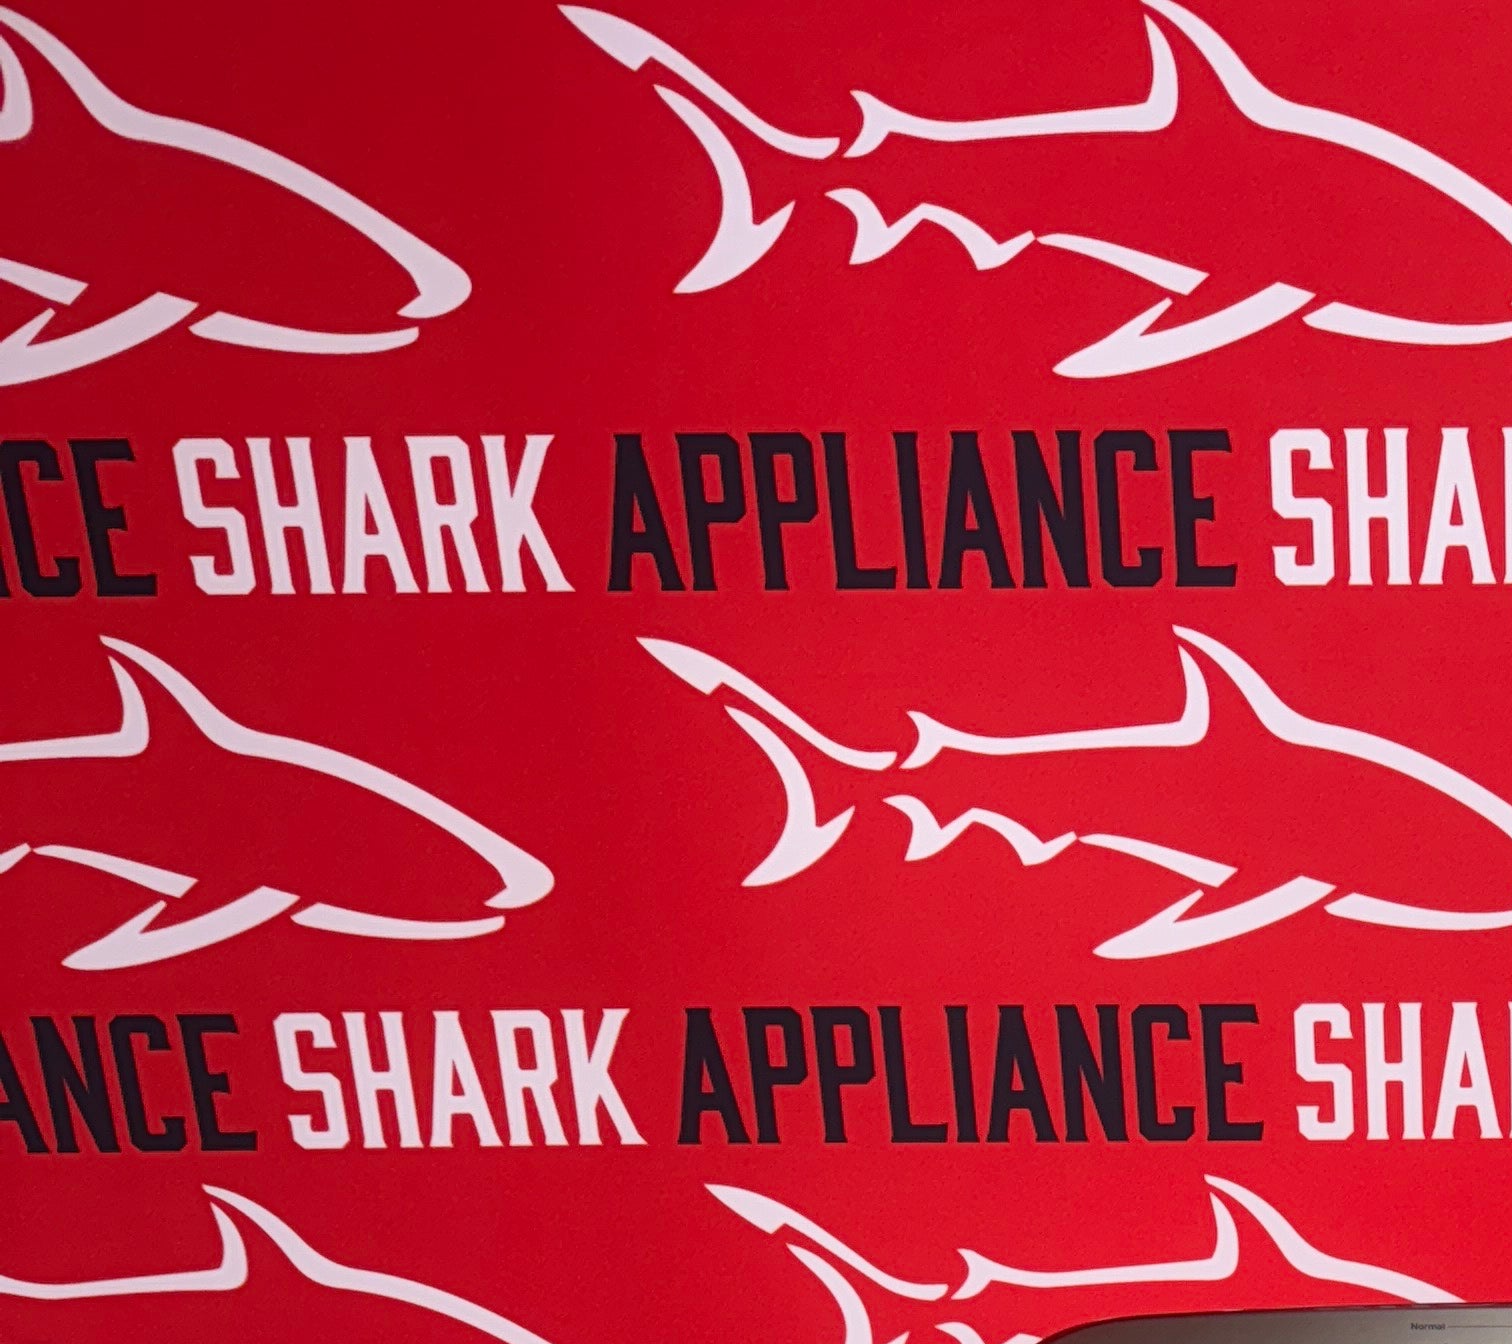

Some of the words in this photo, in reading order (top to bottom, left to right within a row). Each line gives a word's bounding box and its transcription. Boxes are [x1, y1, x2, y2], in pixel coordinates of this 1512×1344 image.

[0, 438, 157, 598] CE
[172, 434, 575, 596] SHARK
[607, 430, 1236, 592] APPLIANCE
[273, 1008, 648, 1150] SHARK
[678, 1004, 1263, 1144] APPLIANCE
[1411, 1322, 1445, 1330] Normal
